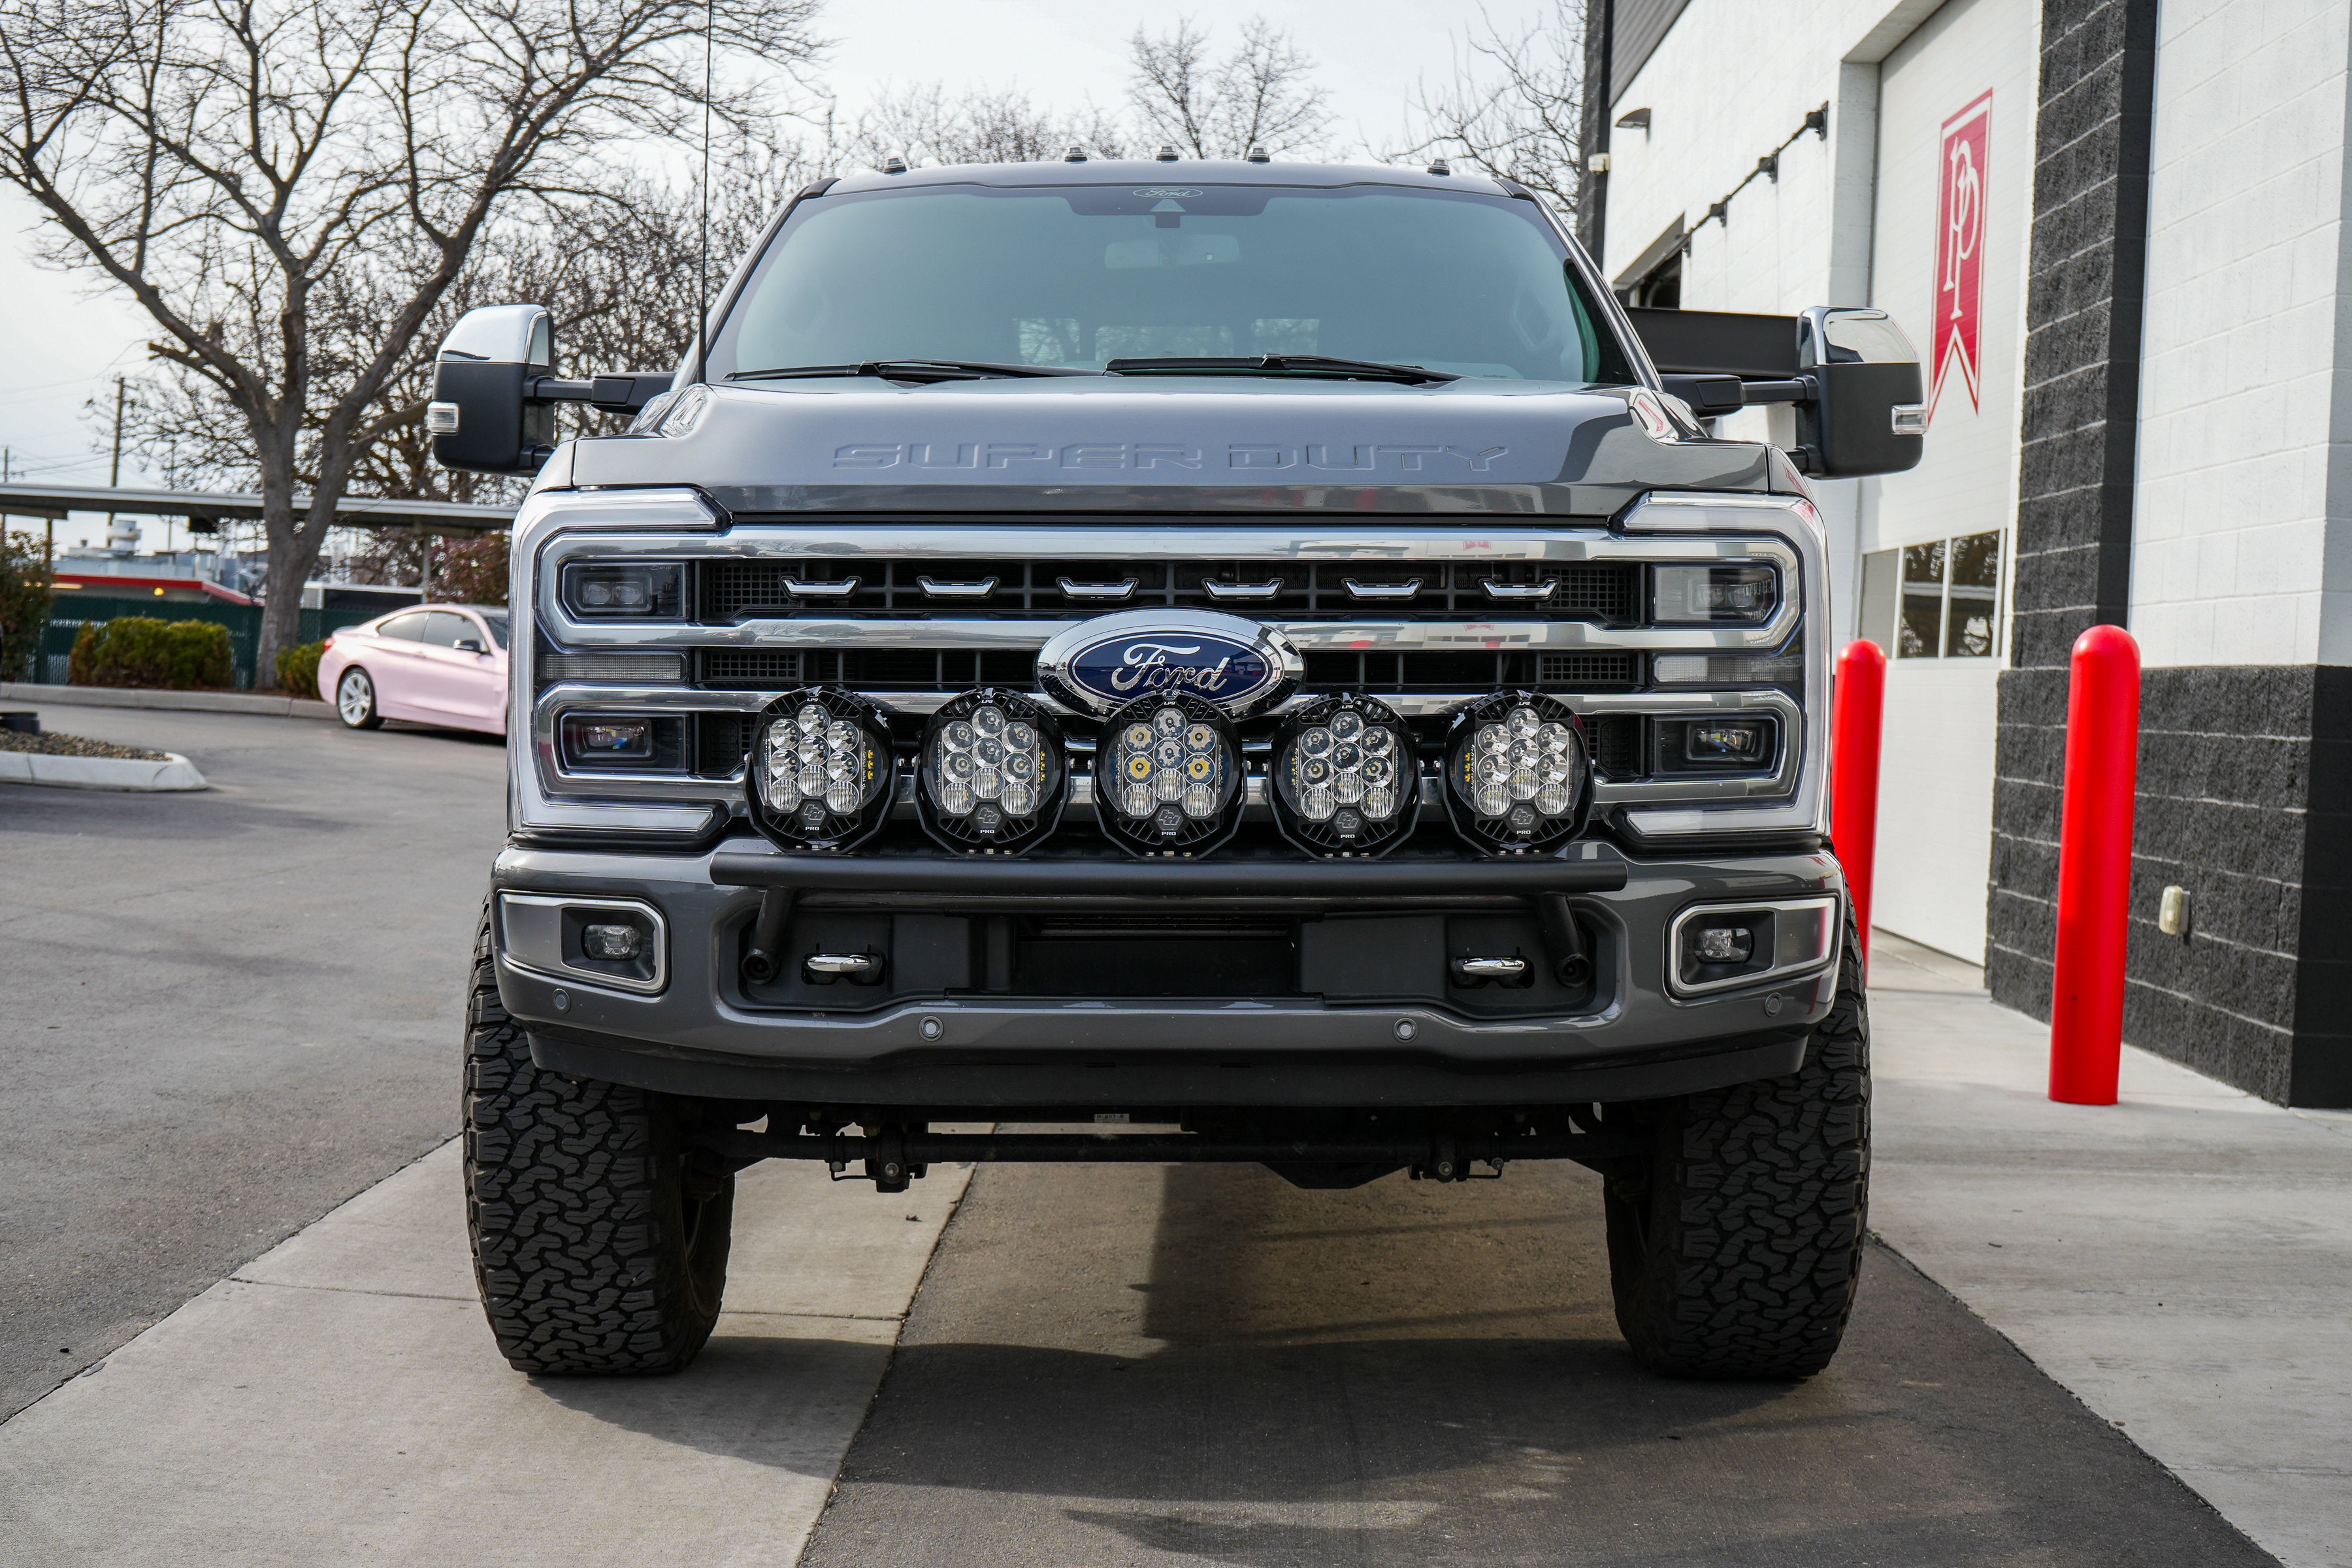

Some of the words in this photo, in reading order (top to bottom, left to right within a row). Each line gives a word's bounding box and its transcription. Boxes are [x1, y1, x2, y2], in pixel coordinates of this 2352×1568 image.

[1145, 188, 1190, 197] Ford
[833, 444, 1202, 469] SUPER
[1228, 444, 1510, 472] DUTY
[1111, 643, 1230, 692] Ford
